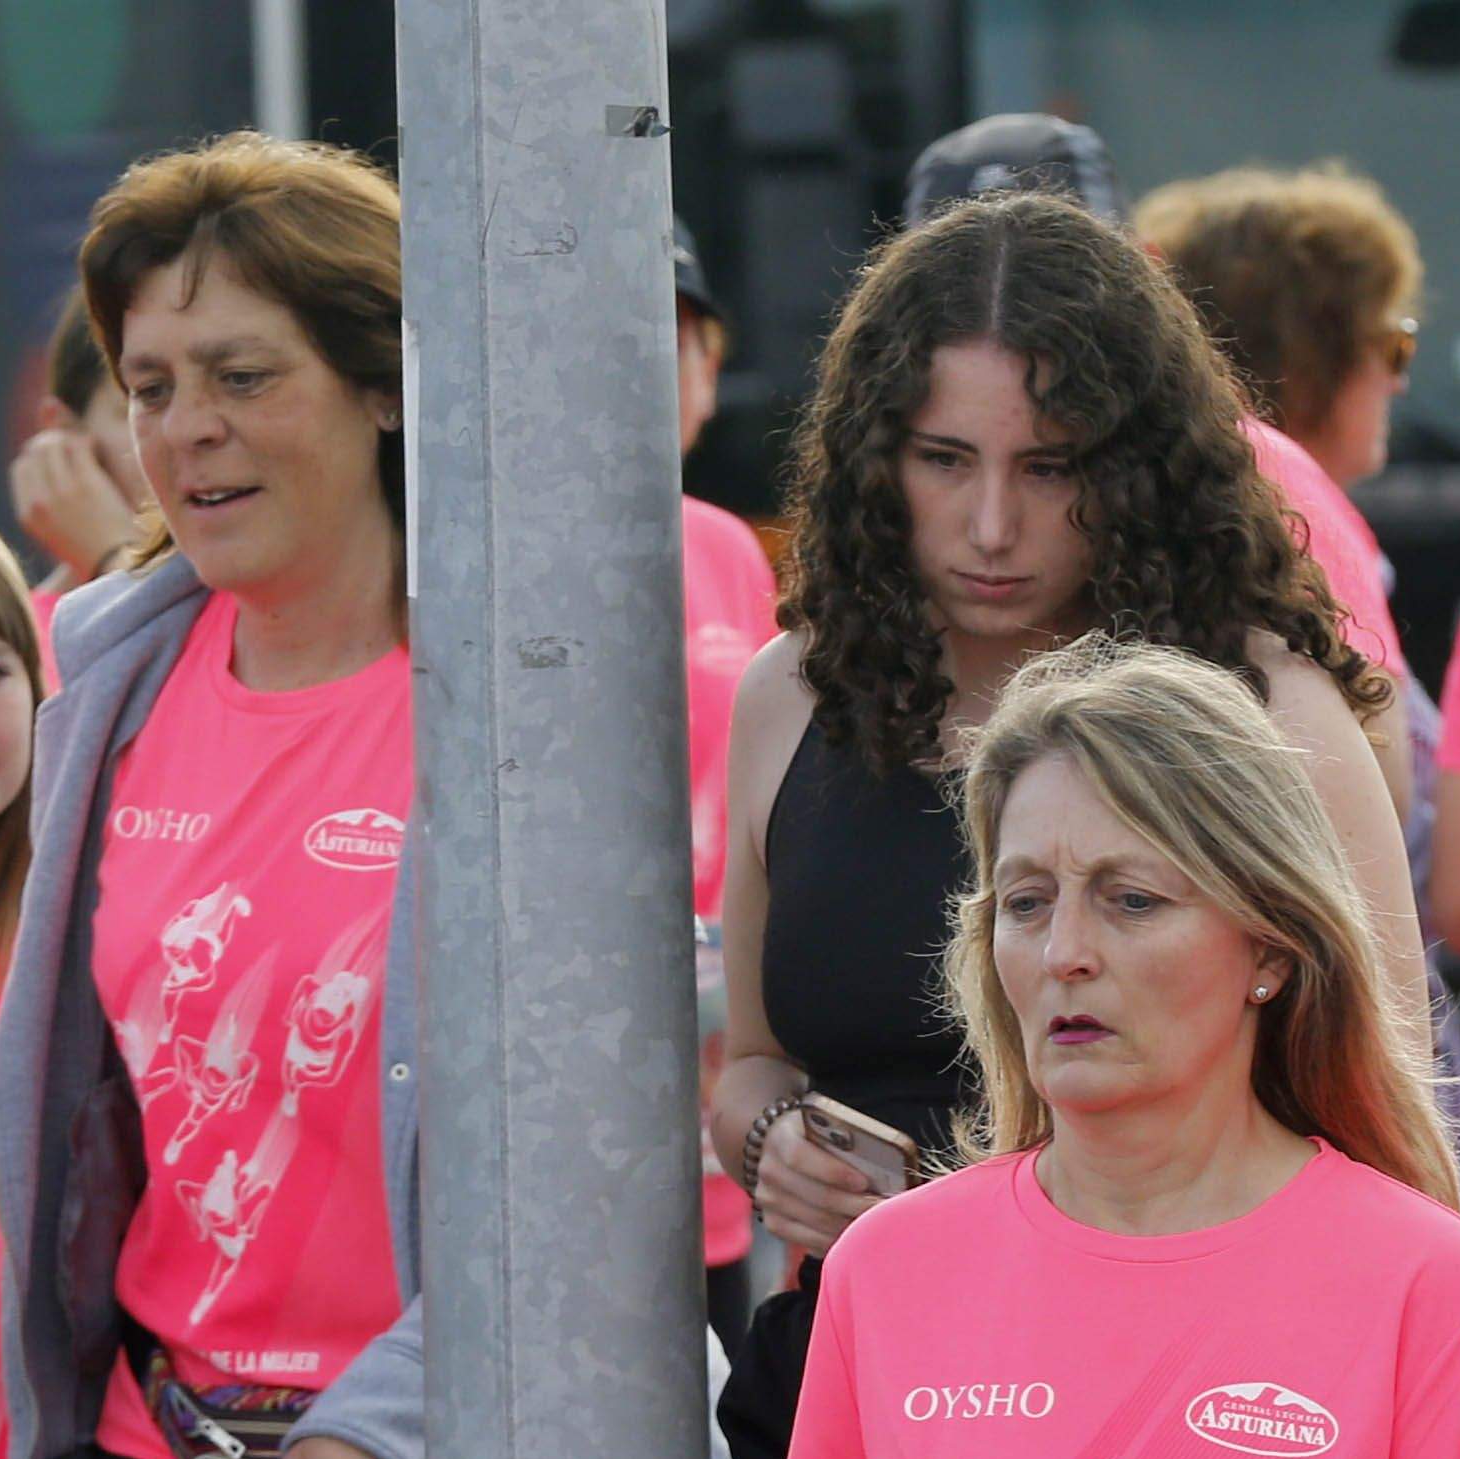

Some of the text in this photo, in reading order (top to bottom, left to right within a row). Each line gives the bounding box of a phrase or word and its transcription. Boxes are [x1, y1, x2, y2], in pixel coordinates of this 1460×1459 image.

[235, 1351, 257, 1374] LA
[904, 1382, 1055, 1422] OYSHO
[1222, 1401, 1325, 1424] CENTRAL LECHERA
[1196, 1400, 1326, 1446] ASTURIANA
